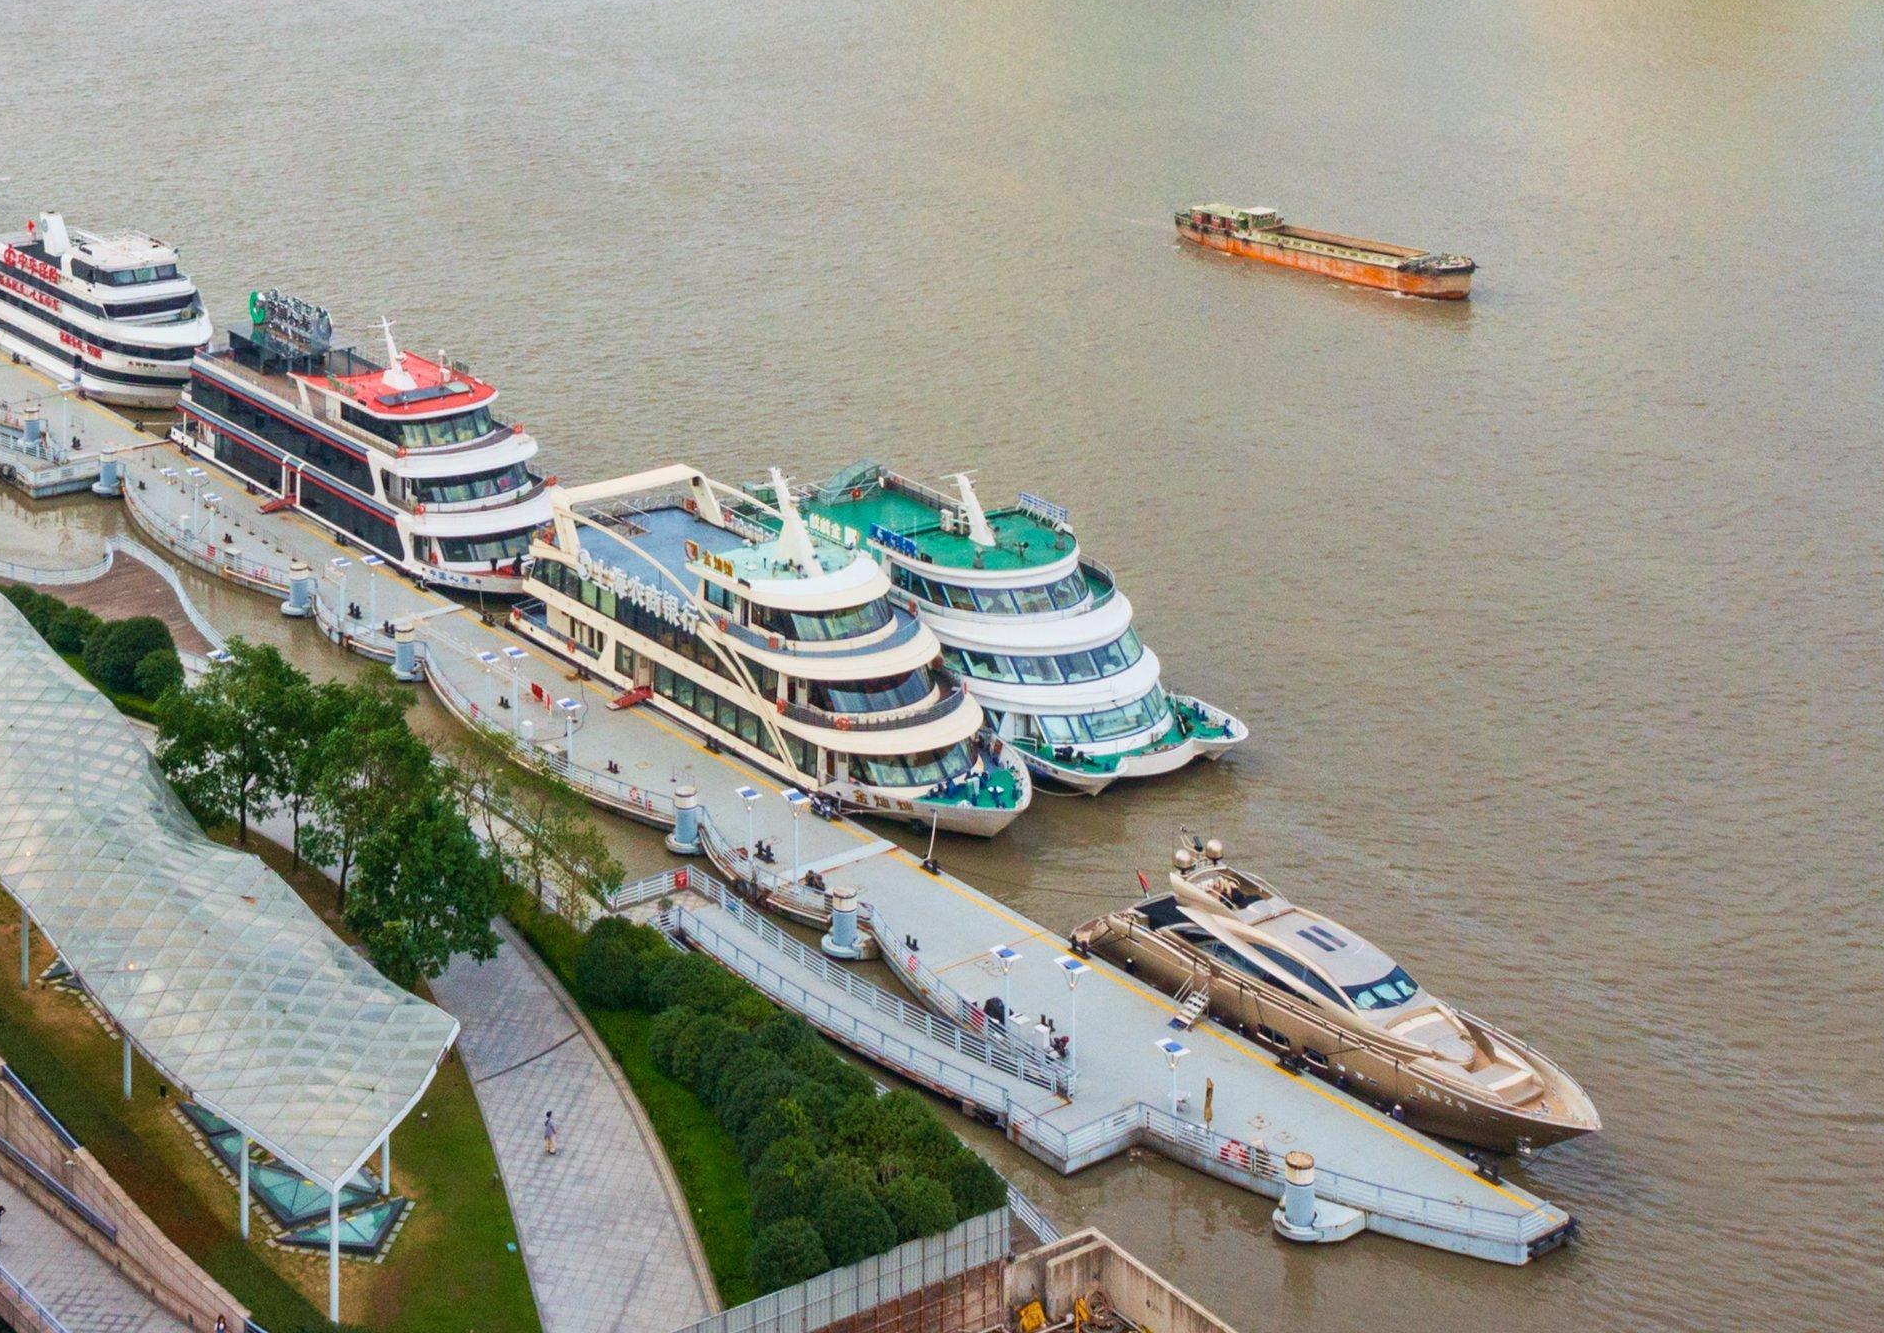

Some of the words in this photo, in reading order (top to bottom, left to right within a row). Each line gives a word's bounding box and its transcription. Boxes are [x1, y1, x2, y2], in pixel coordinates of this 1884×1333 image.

[592, 558, 700, 636] 上海农商银行
